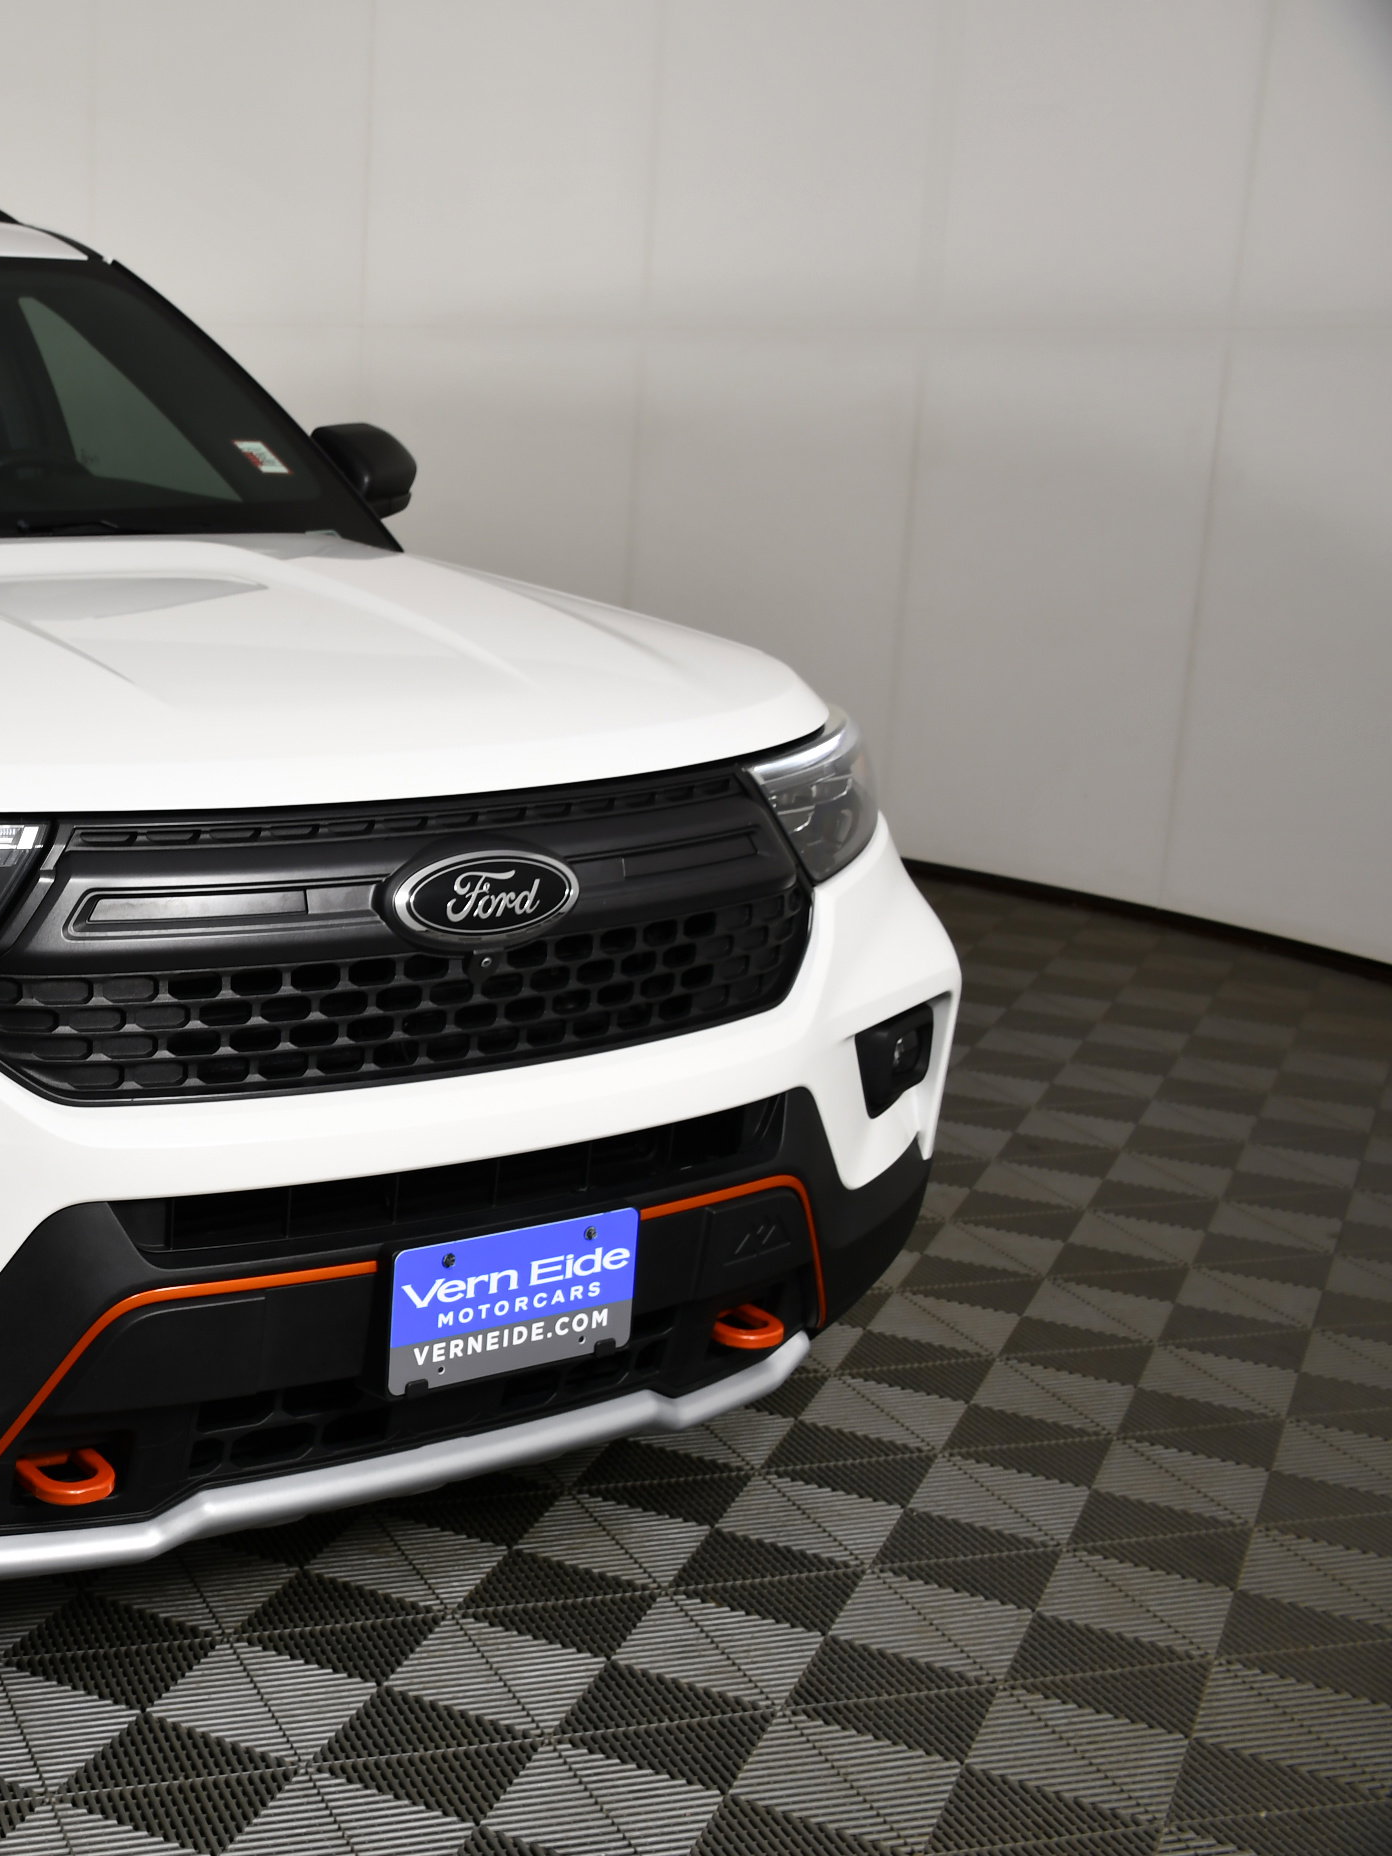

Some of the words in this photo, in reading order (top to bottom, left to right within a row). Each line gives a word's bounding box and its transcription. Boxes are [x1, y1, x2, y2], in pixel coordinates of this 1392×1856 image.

[446, 869, 541, 923] Ford
[401, 1268, 519, 1309] Vern
[528, 1246, 631, 1287] Eide
[436, 1281, 602, 1329] MOTORCARS
[412, 1308, 609, 1366] VERNEIDE.COM
